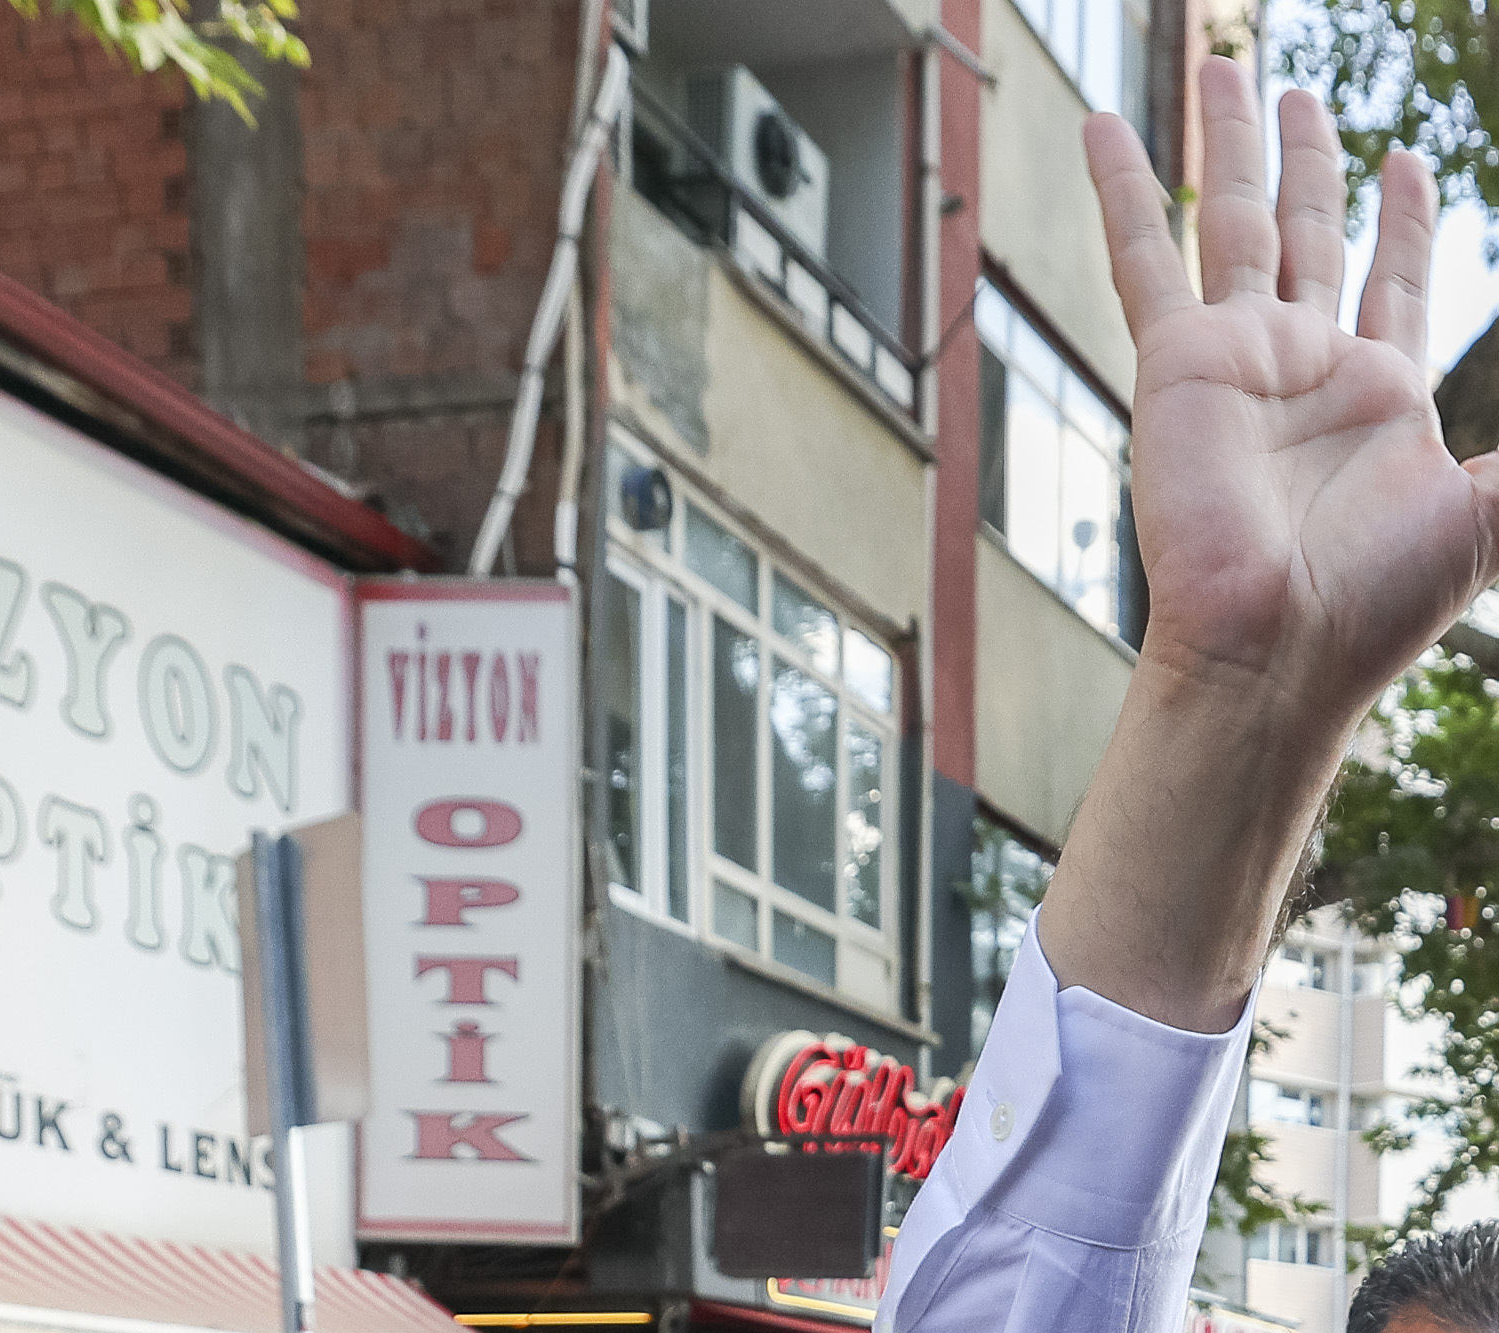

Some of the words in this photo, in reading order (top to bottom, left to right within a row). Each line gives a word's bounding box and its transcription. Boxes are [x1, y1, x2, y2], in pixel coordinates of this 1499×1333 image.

[387, 620, 540, 742] VİZYON
[401, 797, 538, 1163] OPTİK
[98, 1112, 133, 1164] &
